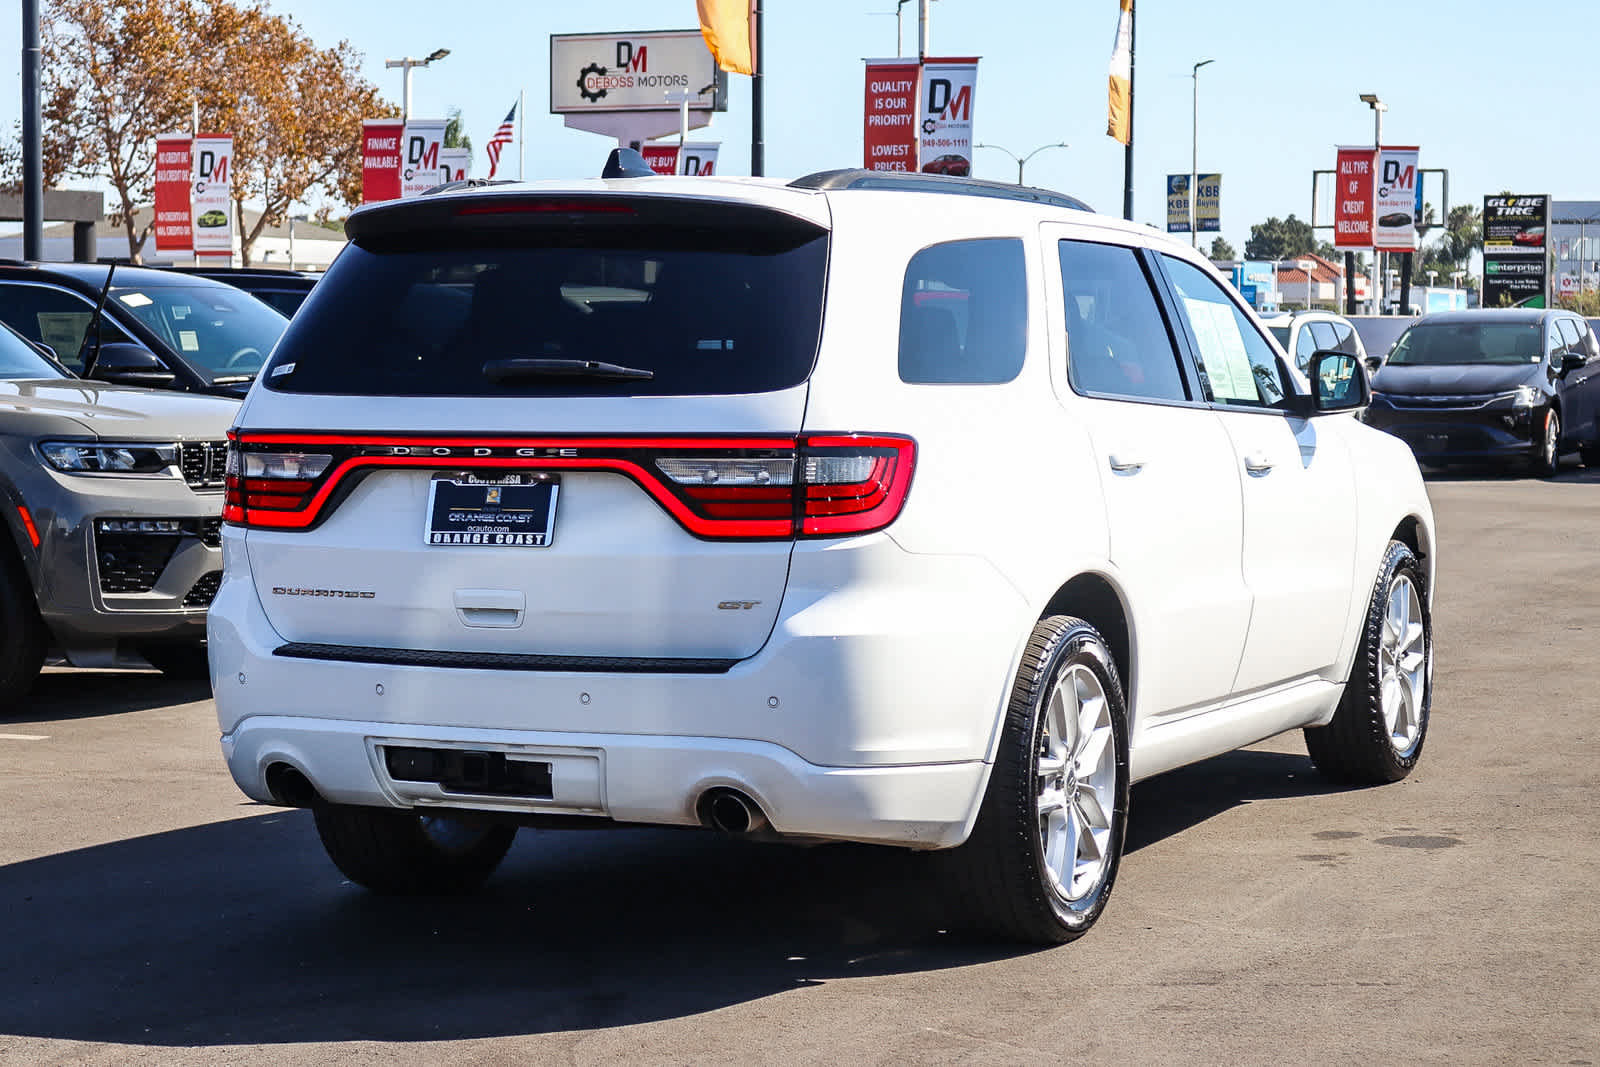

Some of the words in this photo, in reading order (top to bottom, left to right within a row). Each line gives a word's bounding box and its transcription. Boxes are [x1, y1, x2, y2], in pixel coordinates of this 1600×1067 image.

[616, 41, 648, 73] DM
[586, 76, 634, 89] DEBOSS
[637, 75, 689, 87] MOTORS
[871, 81, 912, 93] QUALITY
[875, 98, 884, 109] IS
[885, 98, 907, 109] OUR
[928, 78, 972, 121] DM
[869, 115, 912, 126] PRIORITY
[367, 138, 397, 151] FINANCE
[871, 145, 909, 156] LOWEST
[407, 135, 440, 170] DM
[199, 150, 228, 184] DM
[364, 156, 399, 169] AVAILABLE
[658, 156, 676, 167] BUY
[874, 161, 907, 172] PRICES
[1341, 161, 1352, 174] ALL
[1353, 161, 1369, 174] TYPE
[1383, 160, 1415, 190] DM
[1197, 185, 1219, 197] KBB
[1349, 181, 1359, 194] OF
[1343, 201, 1364, 214] CREDIT
[1487, 198, 1544, 207] GLOBE
[1496, 207, 1535, 215] TIRE
[1338, 221, 1369, 233] WELCOME
[1487, 263, 1543, 273] enterprise
[393, 446, 579, 457] DODGE
[448, 513, 495, 522] ORANGE
[495, 513, 532, 523] COAST
[467, 525, 510, 533] ocauto.com
[432, 533, 490, 544] ORANGE
[494, 533, 544, 545] COAST
[717, 601, 762, 610] GT
